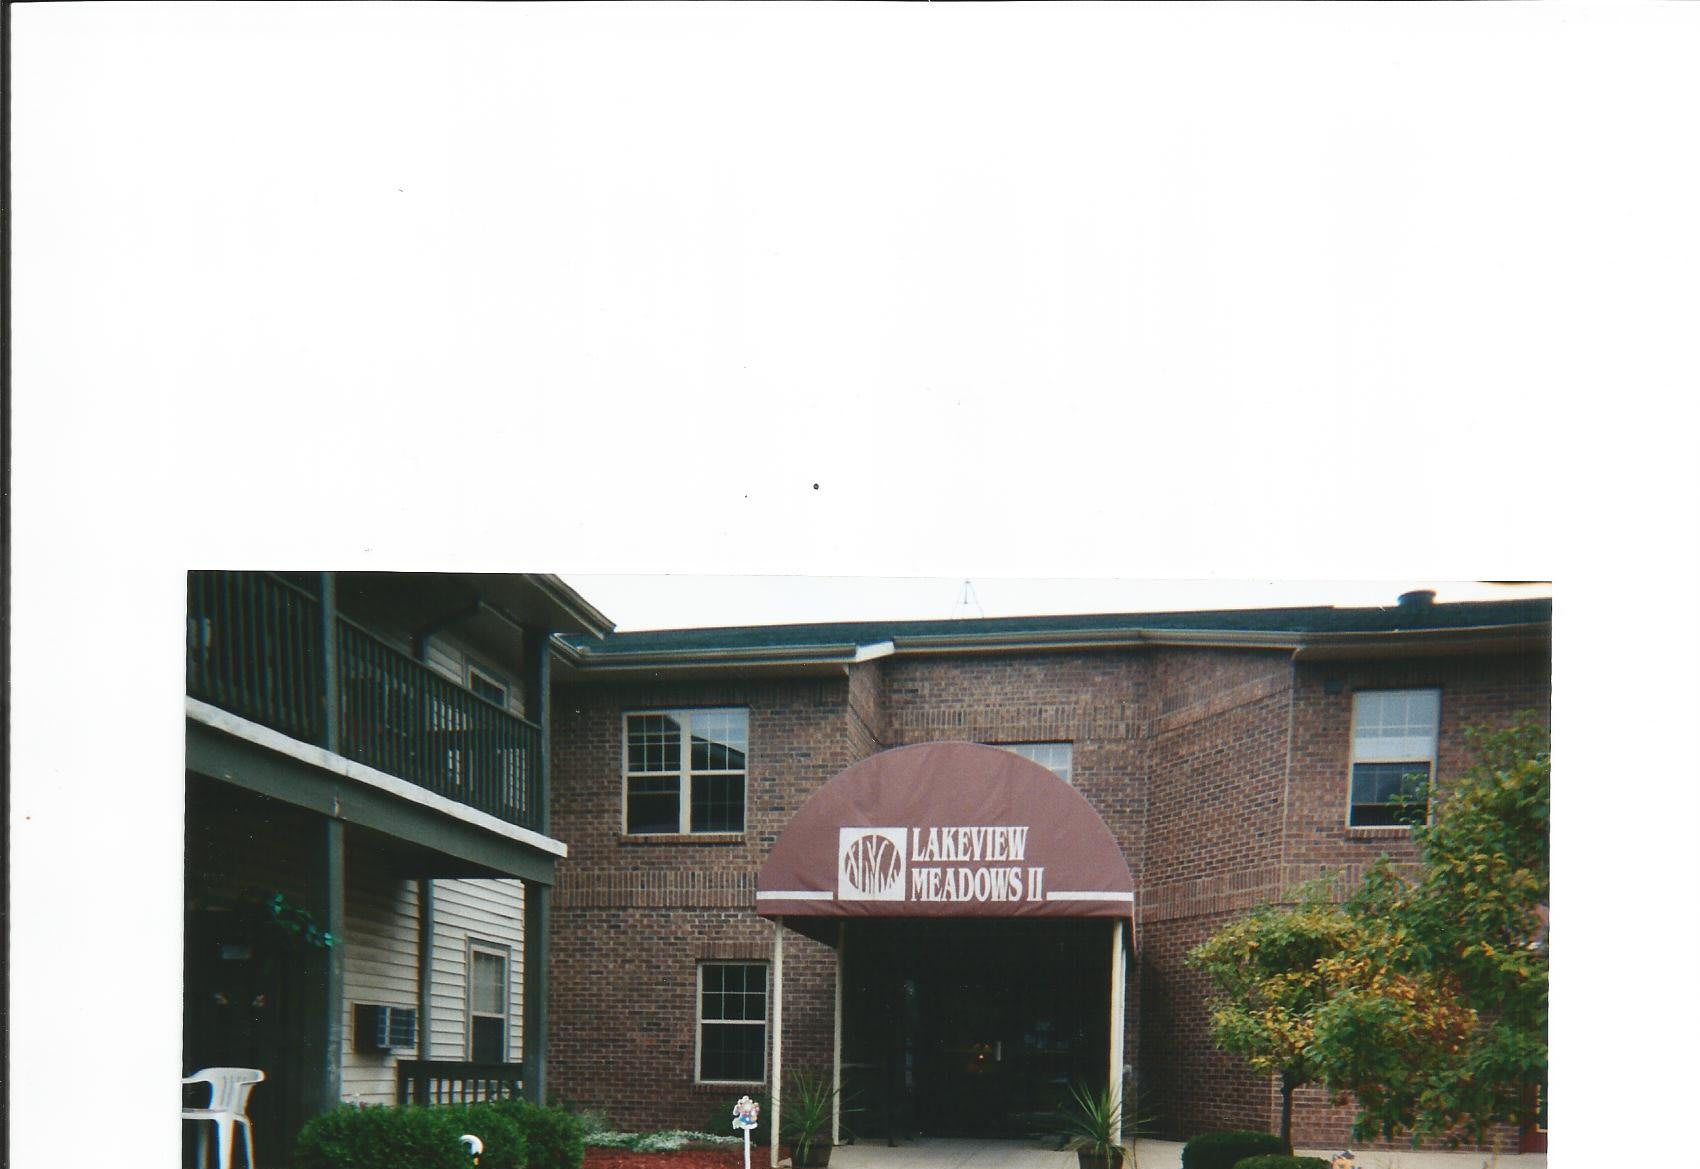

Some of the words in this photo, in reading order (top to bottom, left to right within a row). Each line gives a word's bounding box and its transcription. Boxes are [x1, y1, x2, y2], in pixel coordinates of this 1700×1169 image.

[911, 826, 1029, 862] LAKEVIEW
[911, 867, 1024, 902] MEADOWS
[1026, 867, 1044, 902] II
